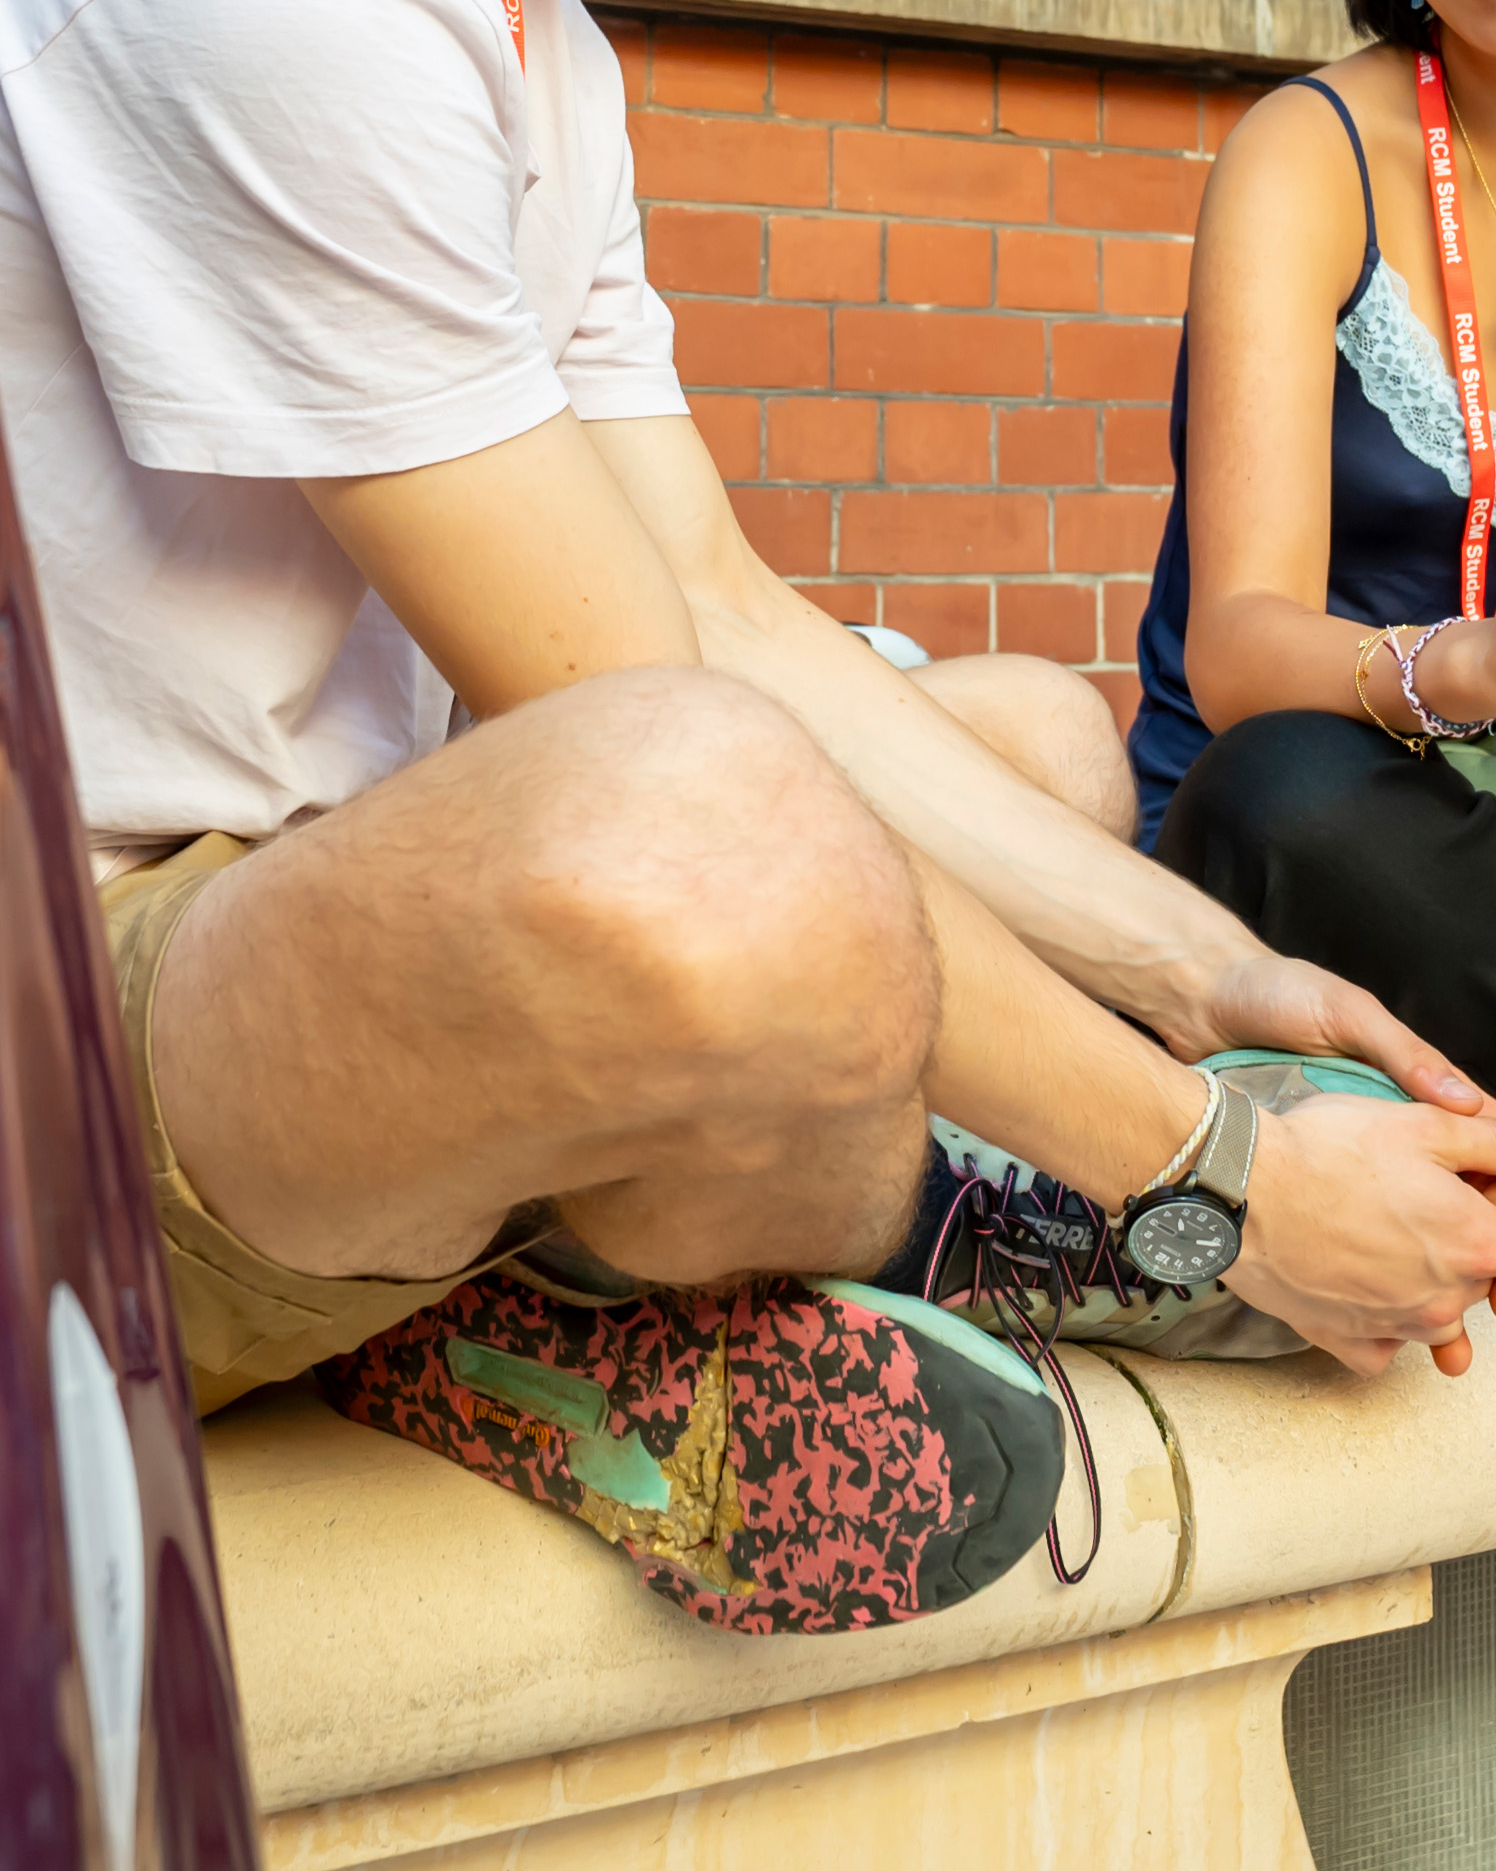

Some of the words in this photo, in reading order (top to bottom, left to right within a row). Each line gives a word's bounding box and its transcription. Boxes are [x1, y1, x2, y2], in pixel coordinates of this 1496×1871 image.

[1428, 127, 1451, 177] RCM
[1436, 182, 1462, 264] Student
[1455, 312, 1477, 363] RCM
[1462, 368, 1488, 452] Student
[1468, 498, 1490, 540] RCM
[1016, 1214, 1094, 1250] TERRE
[1181, 1208, 1191, 1217] 5
[1208, 1224, 1218, 1232] 7
[1154, 1251, 1170, 1265] 12
[1190, 1256, 1203, 1267] 10
